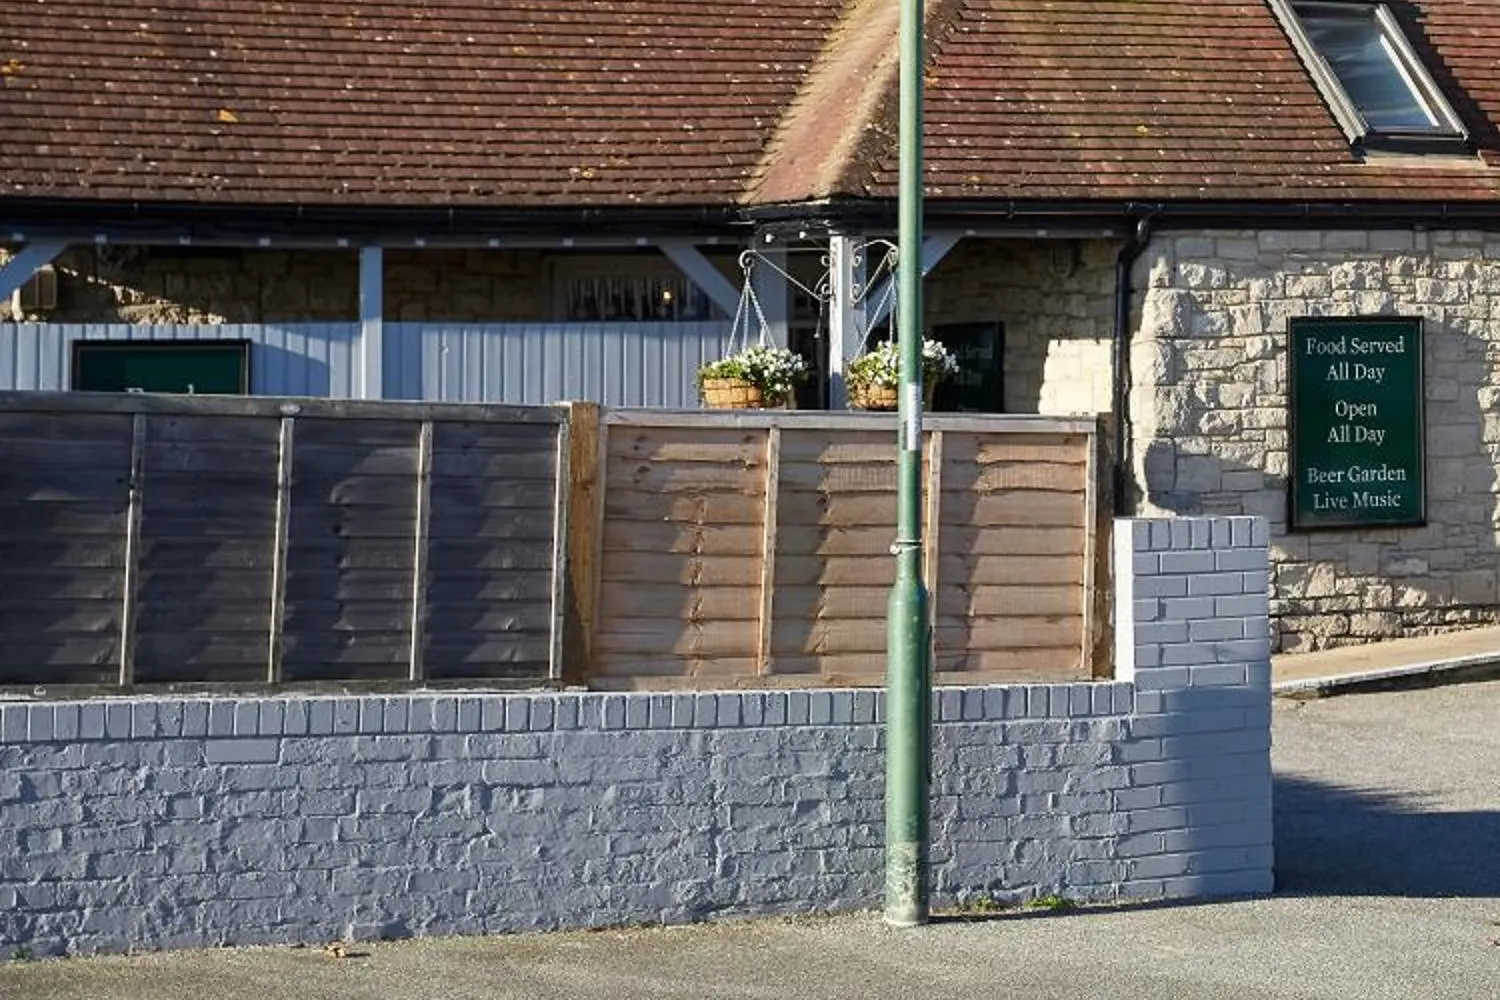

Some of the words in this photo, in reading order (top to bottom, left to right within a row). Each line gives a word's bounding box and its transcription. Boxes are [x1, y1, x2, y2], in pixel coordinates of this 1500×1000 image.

[1306, 336, 1345, 355] Food
[1351, 336, 1405, 353] Served
[1326, 362, 1349, 381] All
[1355, 363, 1385, 383] Day
[1335, 400, 1377, 420] Open
[1328, 424, 1350, 442] All
[1355, 426, 1385, 446] Day
[1307, 467, 1344, 483] Beer
[1348, 464, 1406, 482] Garden
[1313, 493, 1348, 509] Live
[1352, 490, 1401, 508] Music
